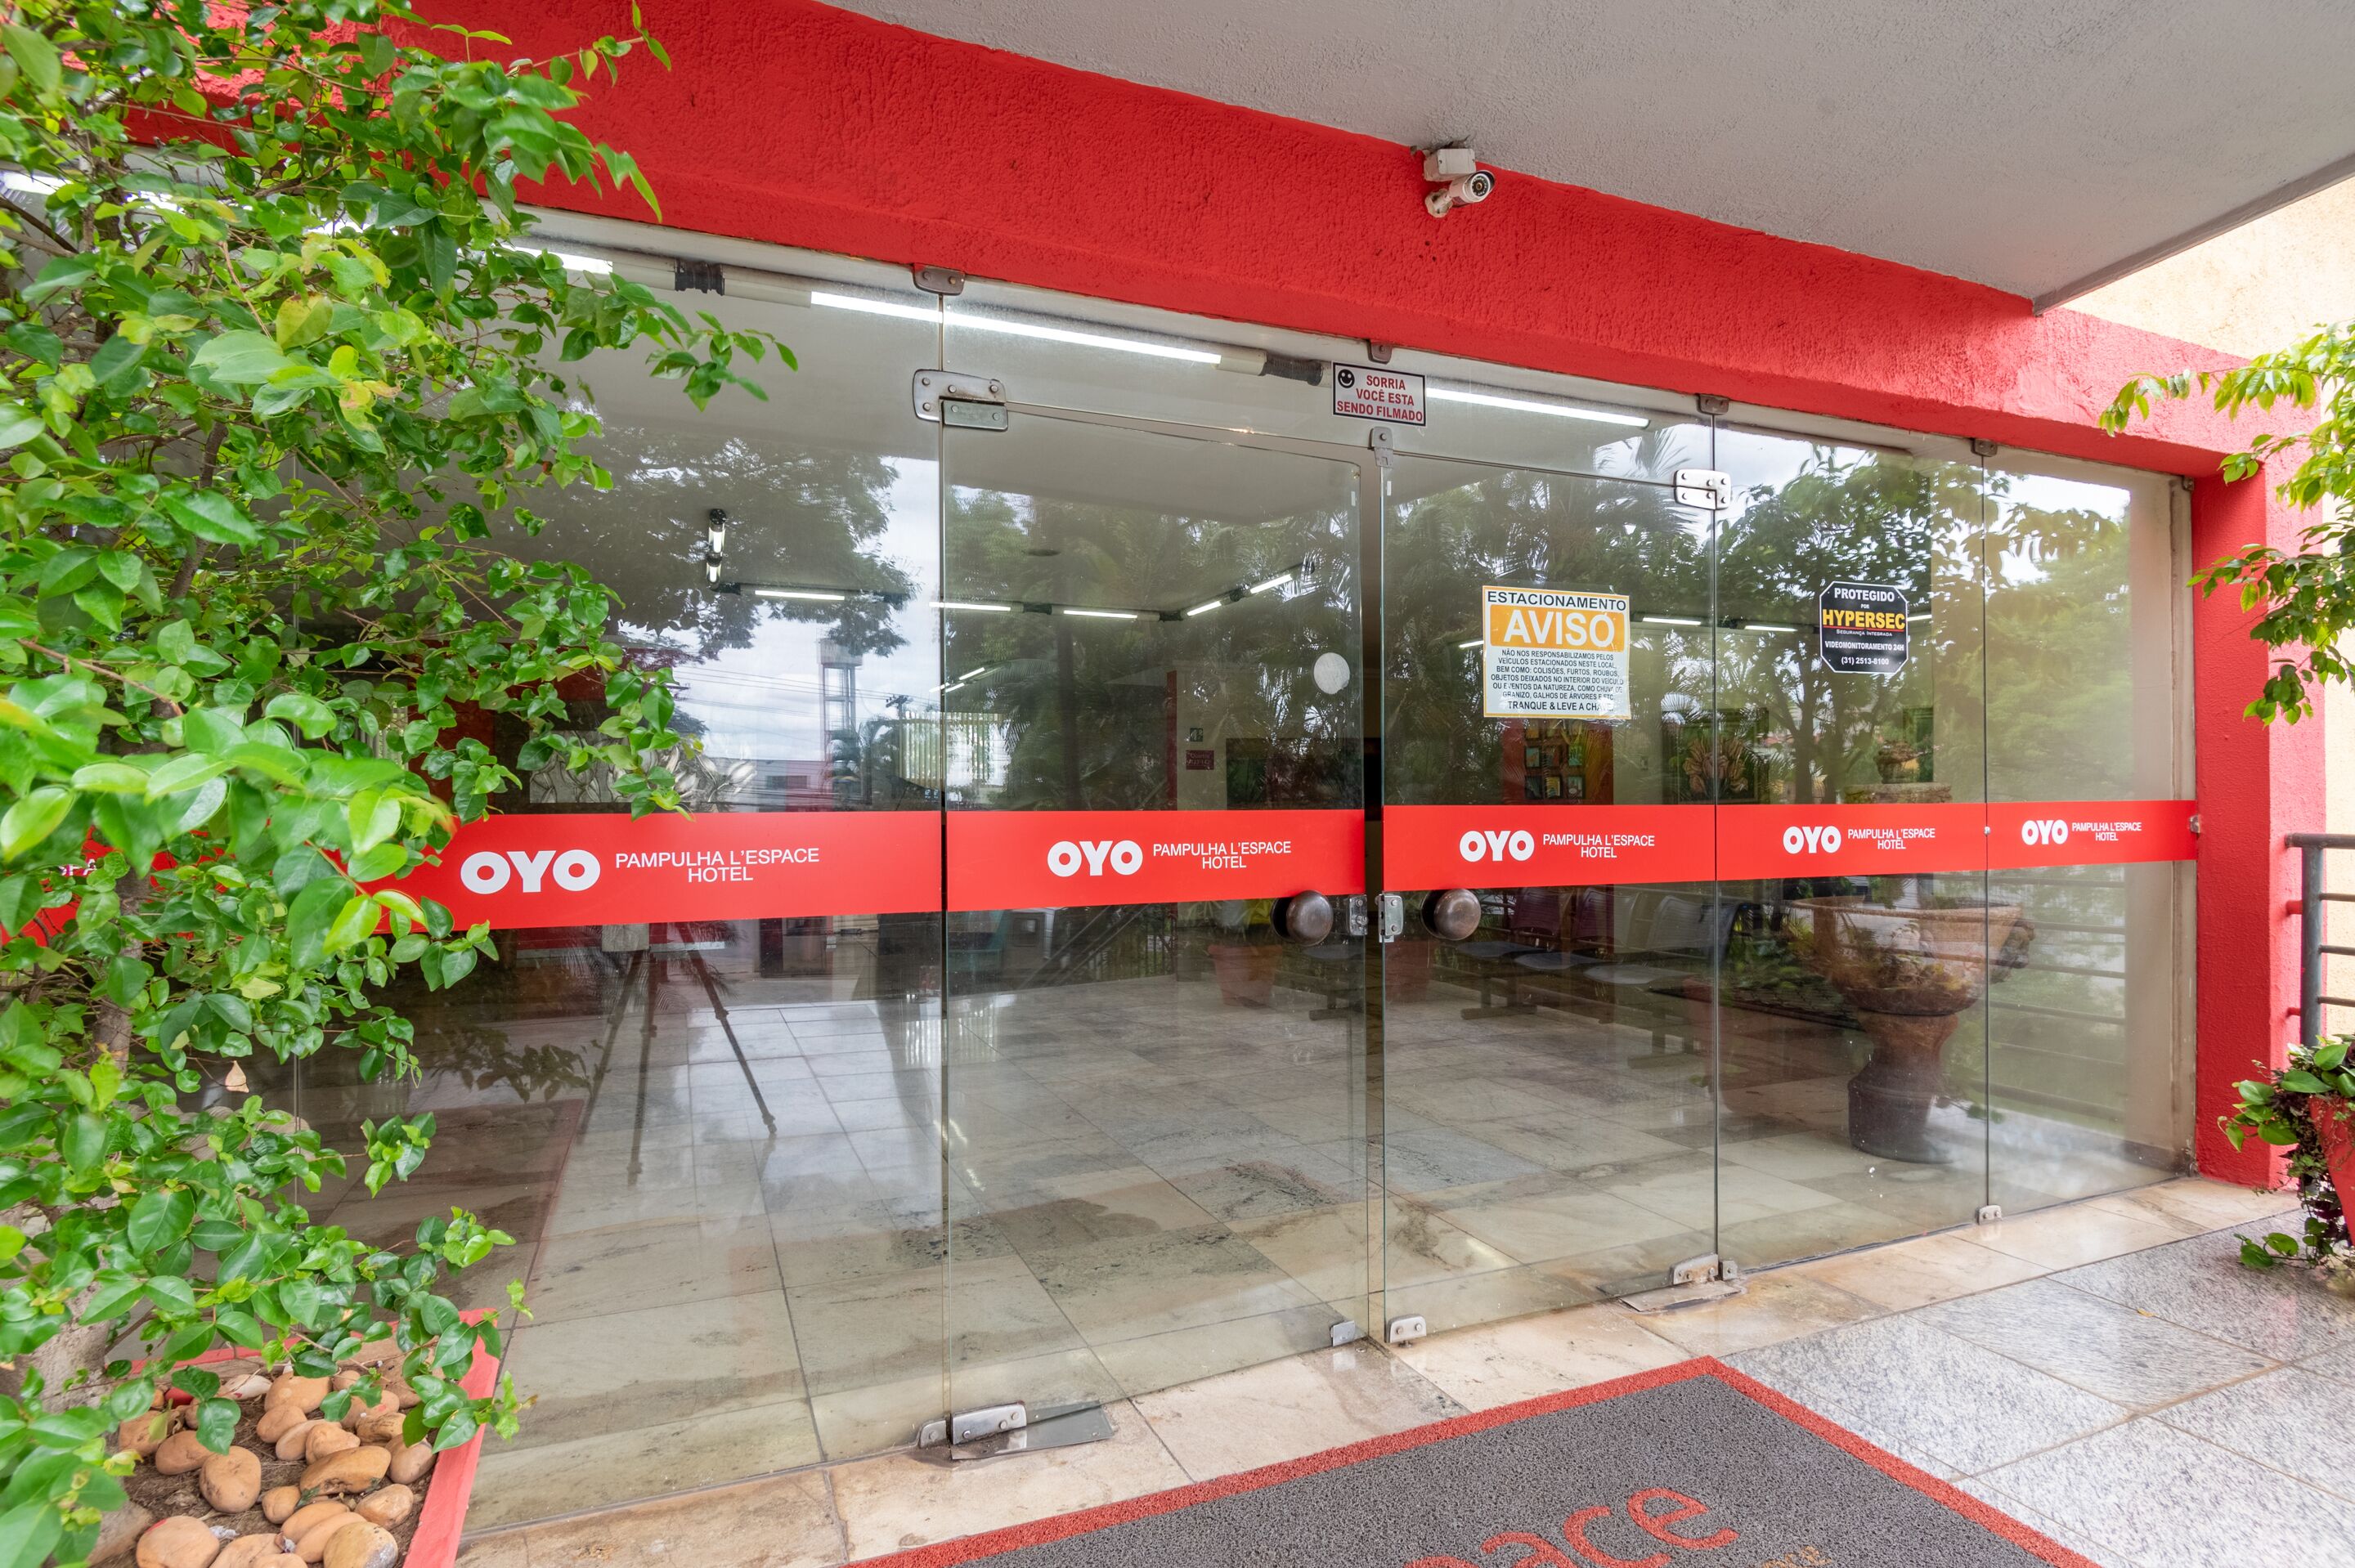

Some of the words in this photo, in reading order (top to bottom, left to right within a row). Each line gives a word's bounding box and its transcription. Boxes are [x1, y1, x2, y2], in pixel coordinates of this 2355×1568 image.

[1366, 375, 1406, 390] SORRIA
[1356, 388, 1384, 401] VOCÊ
[1388, 393, 1414, 405] ESTA
[1337, 401, 1373, 414] SENDO
[1377, 405, 1422, 421] FILMADO
[1488, 591, 1626, 611] ESTACIONAMENTO
[1834, 588, 1895, 602] PROTEGIDO
[1823, 609, 1905, 629] HYPERSEC
[1504, 610, 1615, 647] AVISO
[1825, 641, 1891, 650] VIDEOMONITORAMENTO
[1532, 651, 1595, 659] RESPONSABILIZAMOS
[1841, 656, 1855, 665] (31)
[1533, 667, 1565, 675] COLISÕES,
[1569, 692, 1597, 700] ÁRVORES
[1509, 701, 1546, 710] TRANQUE
[1550, 701, 1555, 710] &
[1557, 702, 1577, 710] LEVE
[1579, 702, 1586, 710] A
[1848, 829, 1894, 839] PAMPULHA
[1896, 828, 1936, 839] L'ESPACE
[2021, 820, 2068, 845] OYO
[2072, 822, 2110, 831] PAMPULHA
[2111, 822, 2142, 831] L'ESPACE
[1543, 834, 1602, 845] PAMPULHA
[1605, 835, 1654, 846] L'ESPACE
[1783, 826, 1841, 853] OYO
[2096, 832, 2119, 840] HOTEL
[1154, 843, 1227, 856] PAMPULHA
[1231, 841, 1291, 855] L'ESPACE
[1460, 830, 1534, 862] OYO
[1581, 846, 1617, 858] HOTEL
[1877, 840, 1906, 849] HOTEL
[616, 849, 723, 868] PAMPULHA
[730, 848, 819, 866] L'ESPACE
[1047, 840, 1143, 877] OYO
[1203, 856, 1246, 869] HOTEL
[460, 849, 600, 894] OYO
[688, 866, 753, 883] HOTEL
[1405, 1488, 1739, 1568] ace
